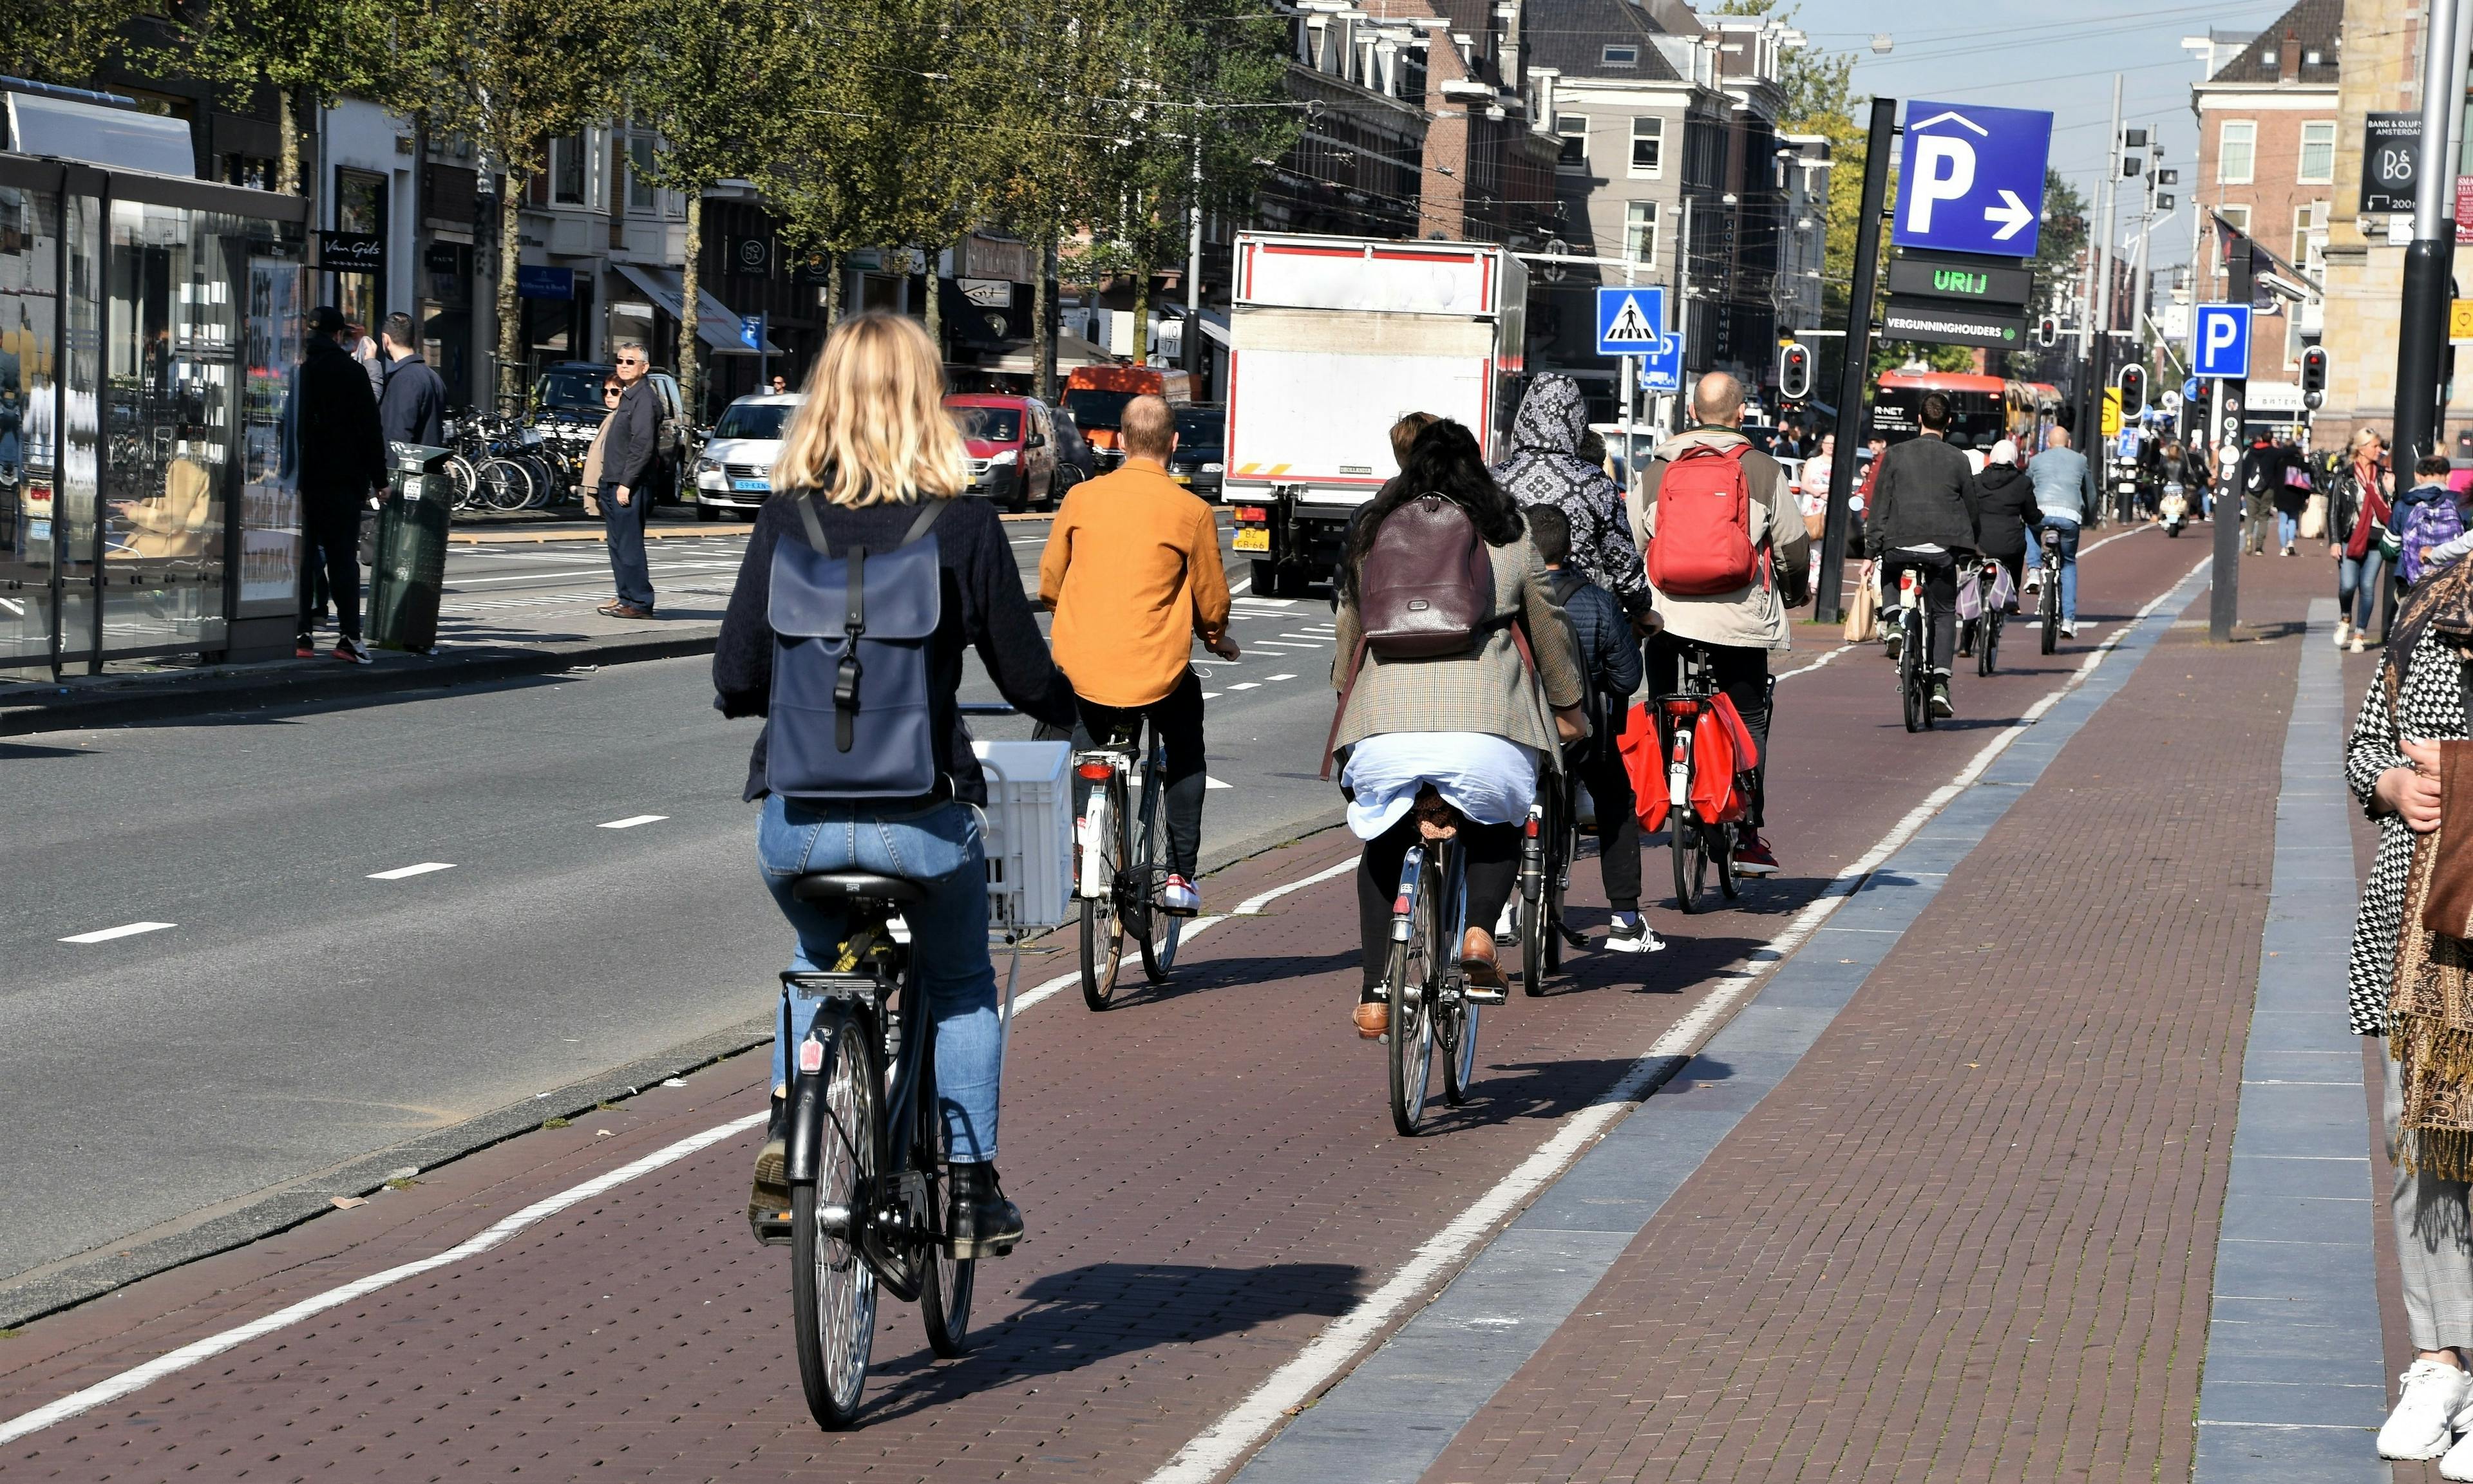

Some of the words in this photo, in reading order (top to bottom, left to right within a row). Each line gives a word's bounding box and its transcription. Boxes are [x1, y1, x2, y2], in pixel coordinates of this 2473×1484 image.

[1906, 134, 1977, 234] P
[2392, 200, 2411, 209] 200
[325, 239, 349, 254] Van
[351, 240, 381, 258] Gils
[1933, 270, 1987, 294] VRIJ
[1886, 317, 2002, 338] VERGUNNINGHOUDERS
[2204, 313, 2237, 368] P
[1245, 529, 1257, 539] BZ
[1236, 540, 1265, 549] GB-66
